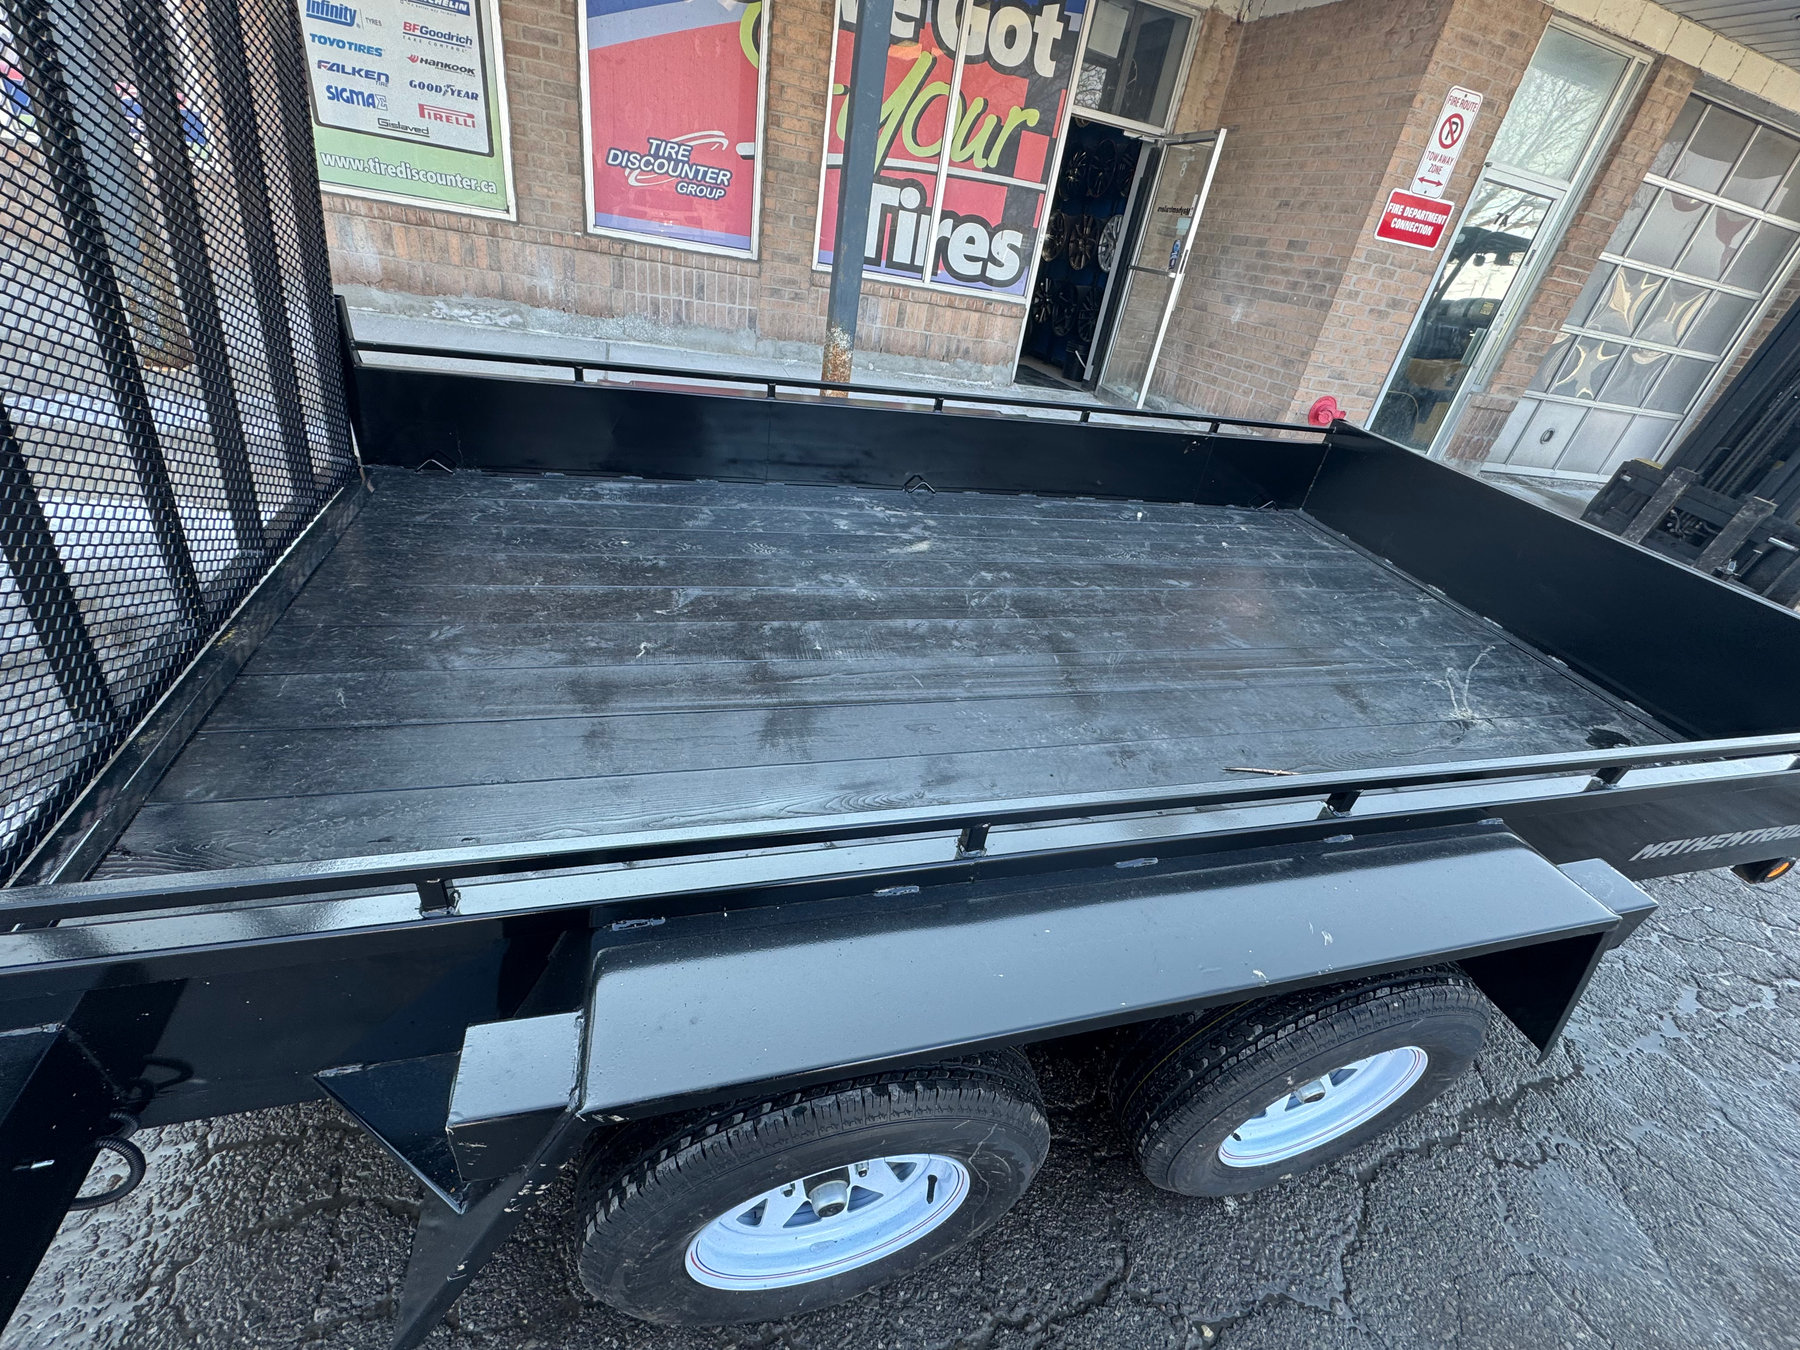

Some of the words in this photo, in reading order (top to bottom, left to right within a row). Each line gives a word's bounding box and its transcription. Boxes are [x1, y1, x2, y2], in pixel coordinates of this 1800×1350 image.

[306, 0, 357, 27] Infinity
[365, 17, 382, 27] TYRES
[403, 21, 473, 46] BFGoodrich
[346, 41, 383, 57] TIRES
[317, 60, 390, 84] FALKEN
[1449, 95, 1461, 108] FIRE
[1459, 99, 1479, 113] ROUTE
[418, 103, 476, 129] PIRELLI
[648, 138, 692, 161] TIRE
[1426, 151, 1440, 162] TOW
[1437, 154, 1455, 166] AWAY
[319, 152, 498, 194] www.tirediscounter.ca
[607, 148, 732, 187] DISCOUNTER
[1428, 163, 1443, 175] ZONE
[676, 181, 726, 200] GROUP
[1386, 202, 1405, 216] FIRE
[1403, 206, 1448, 226] DEPARTMENT
[1390, 217, 1435, 237] CONNECTION
